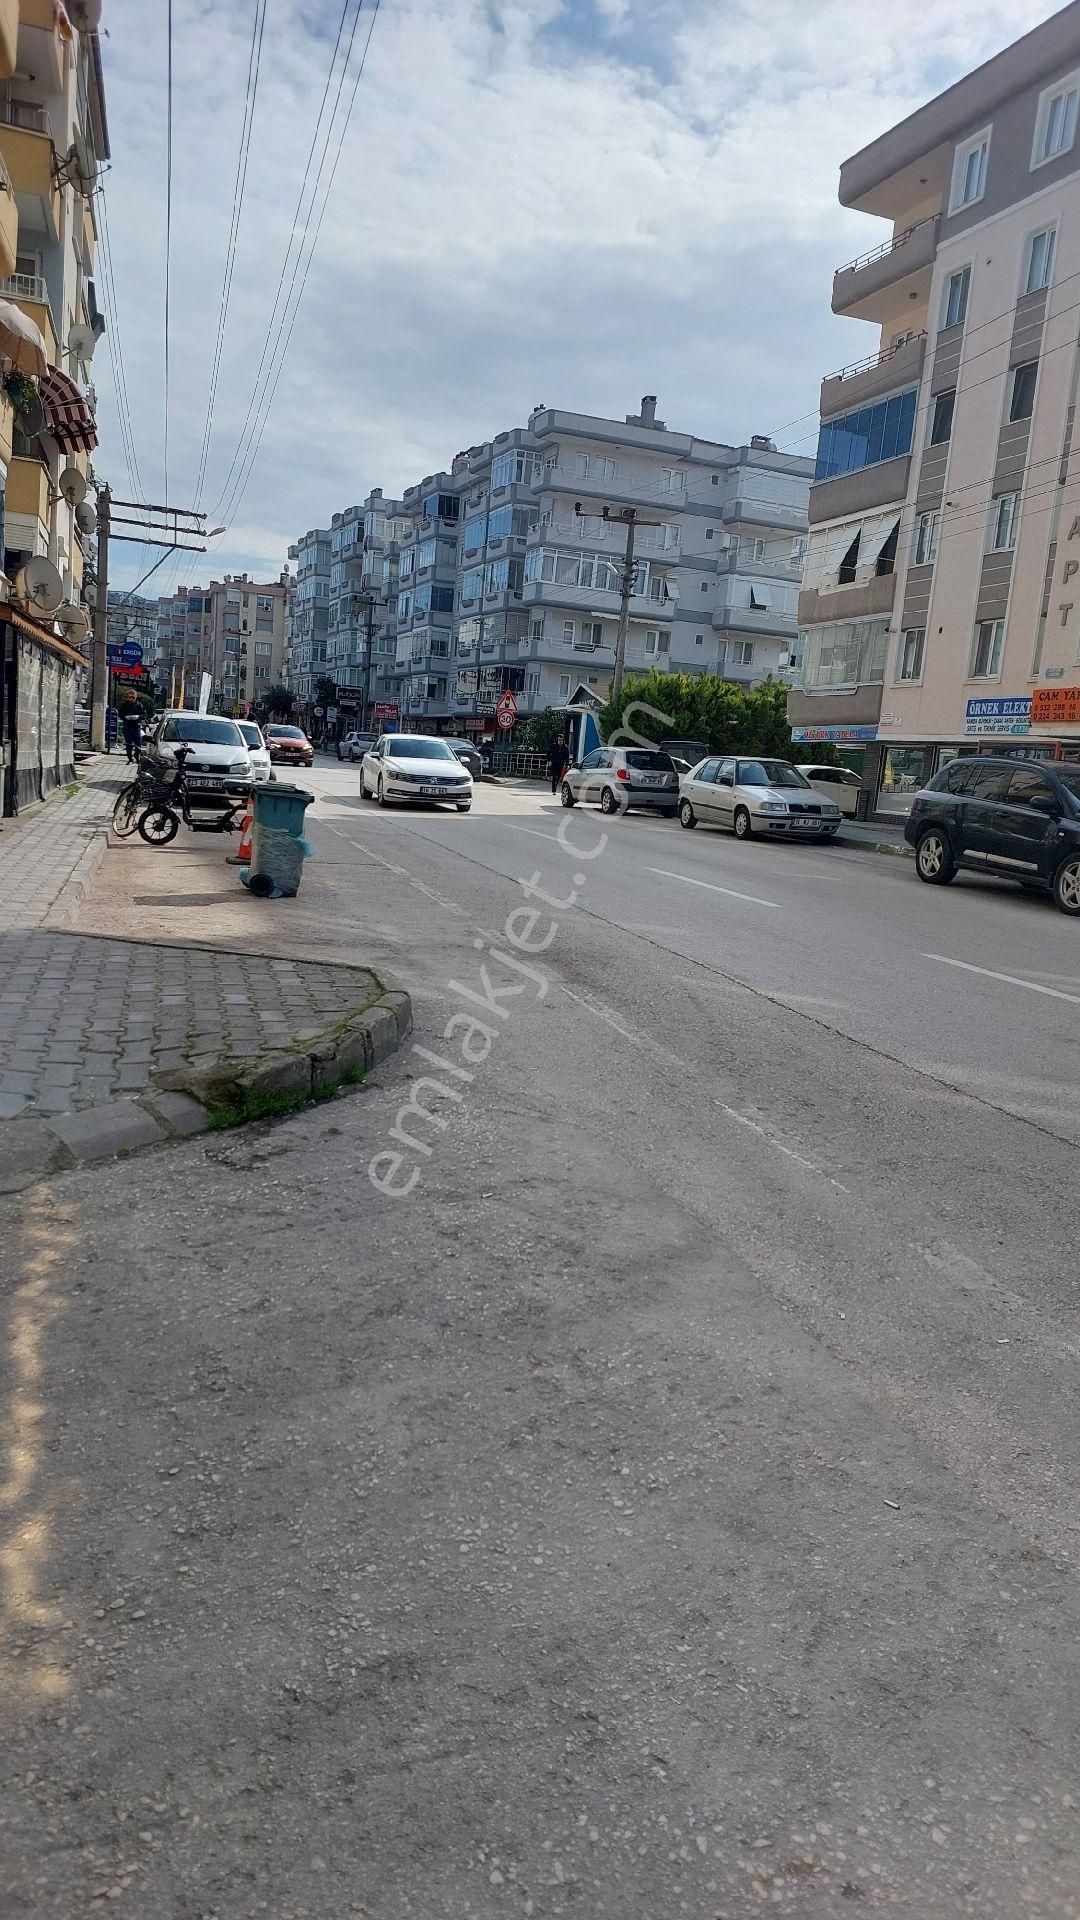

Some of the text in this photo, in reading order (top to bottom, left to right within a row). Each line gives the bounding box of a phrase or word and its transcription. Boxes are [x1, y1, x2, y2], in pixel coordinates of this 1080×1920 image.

[1039, 691, 1059, 701] CAM
[969, 700, 1000, 715] ÖRNEK
[501, 715, 511, 723] 30
